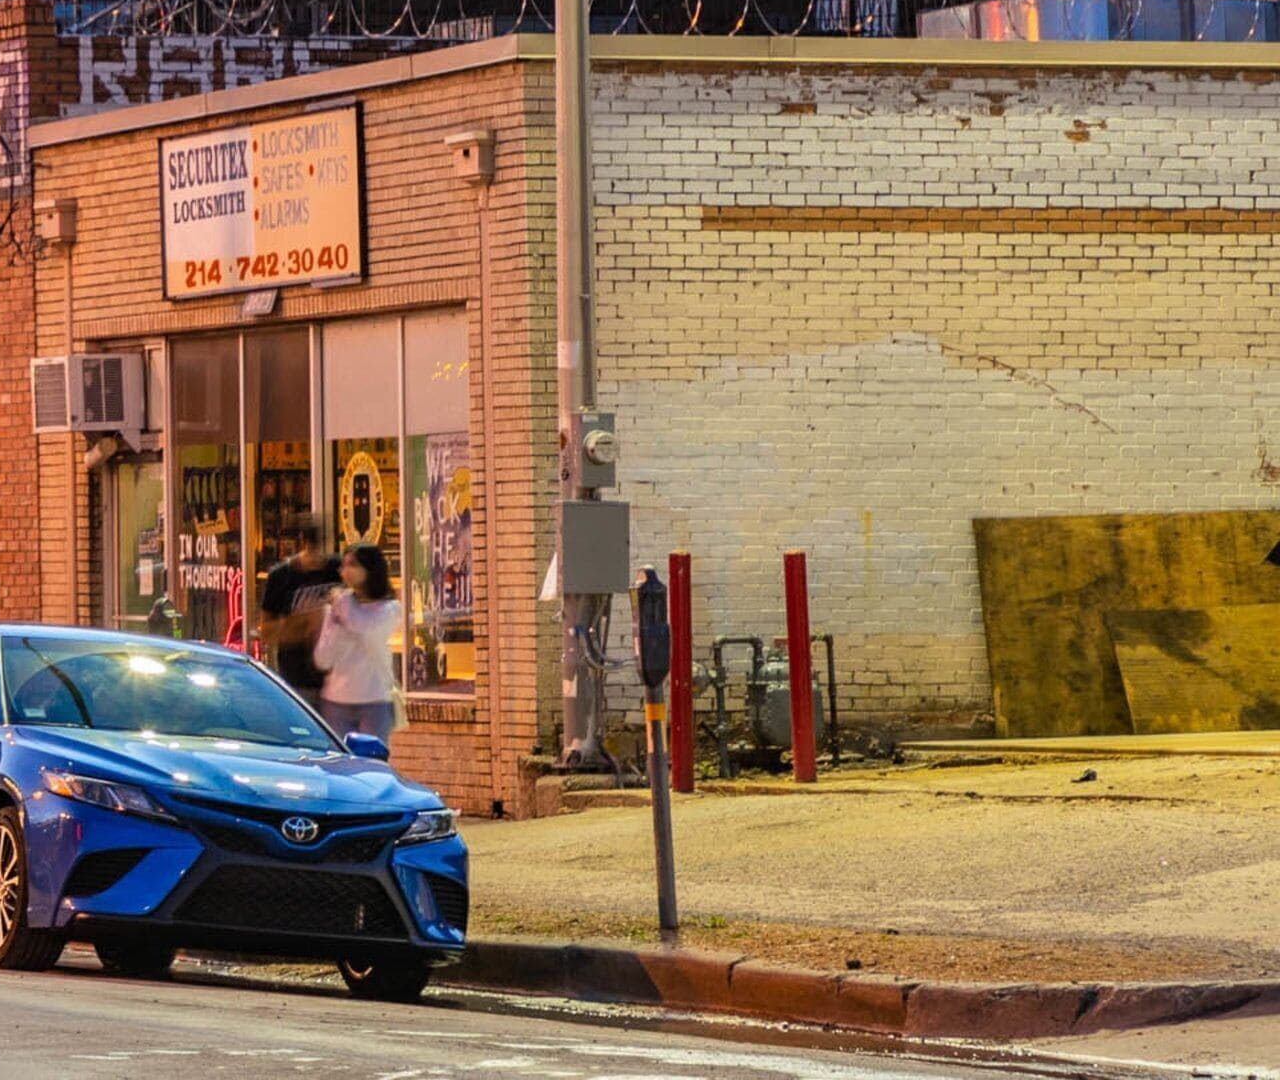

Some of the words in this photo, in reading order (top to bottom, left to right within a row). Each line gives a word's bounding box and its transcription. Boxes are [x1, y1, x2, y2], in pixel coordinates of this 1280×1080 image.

[261, 121, 339, 159] LOCKSMITH
[168, 139, 248, 191] SECURITEX
[261, 162, 304, 195] SAFES
[315, 154, 349, 184] KEYS
[173, 190, 246, 224] LOCKSMITH
[260, 197, 310, 230] ALARMS
[179, 533, 193, 560] IN
[195, 533, 219, 559] OUR
[179, 564, 234, 592] THOUGHTS
